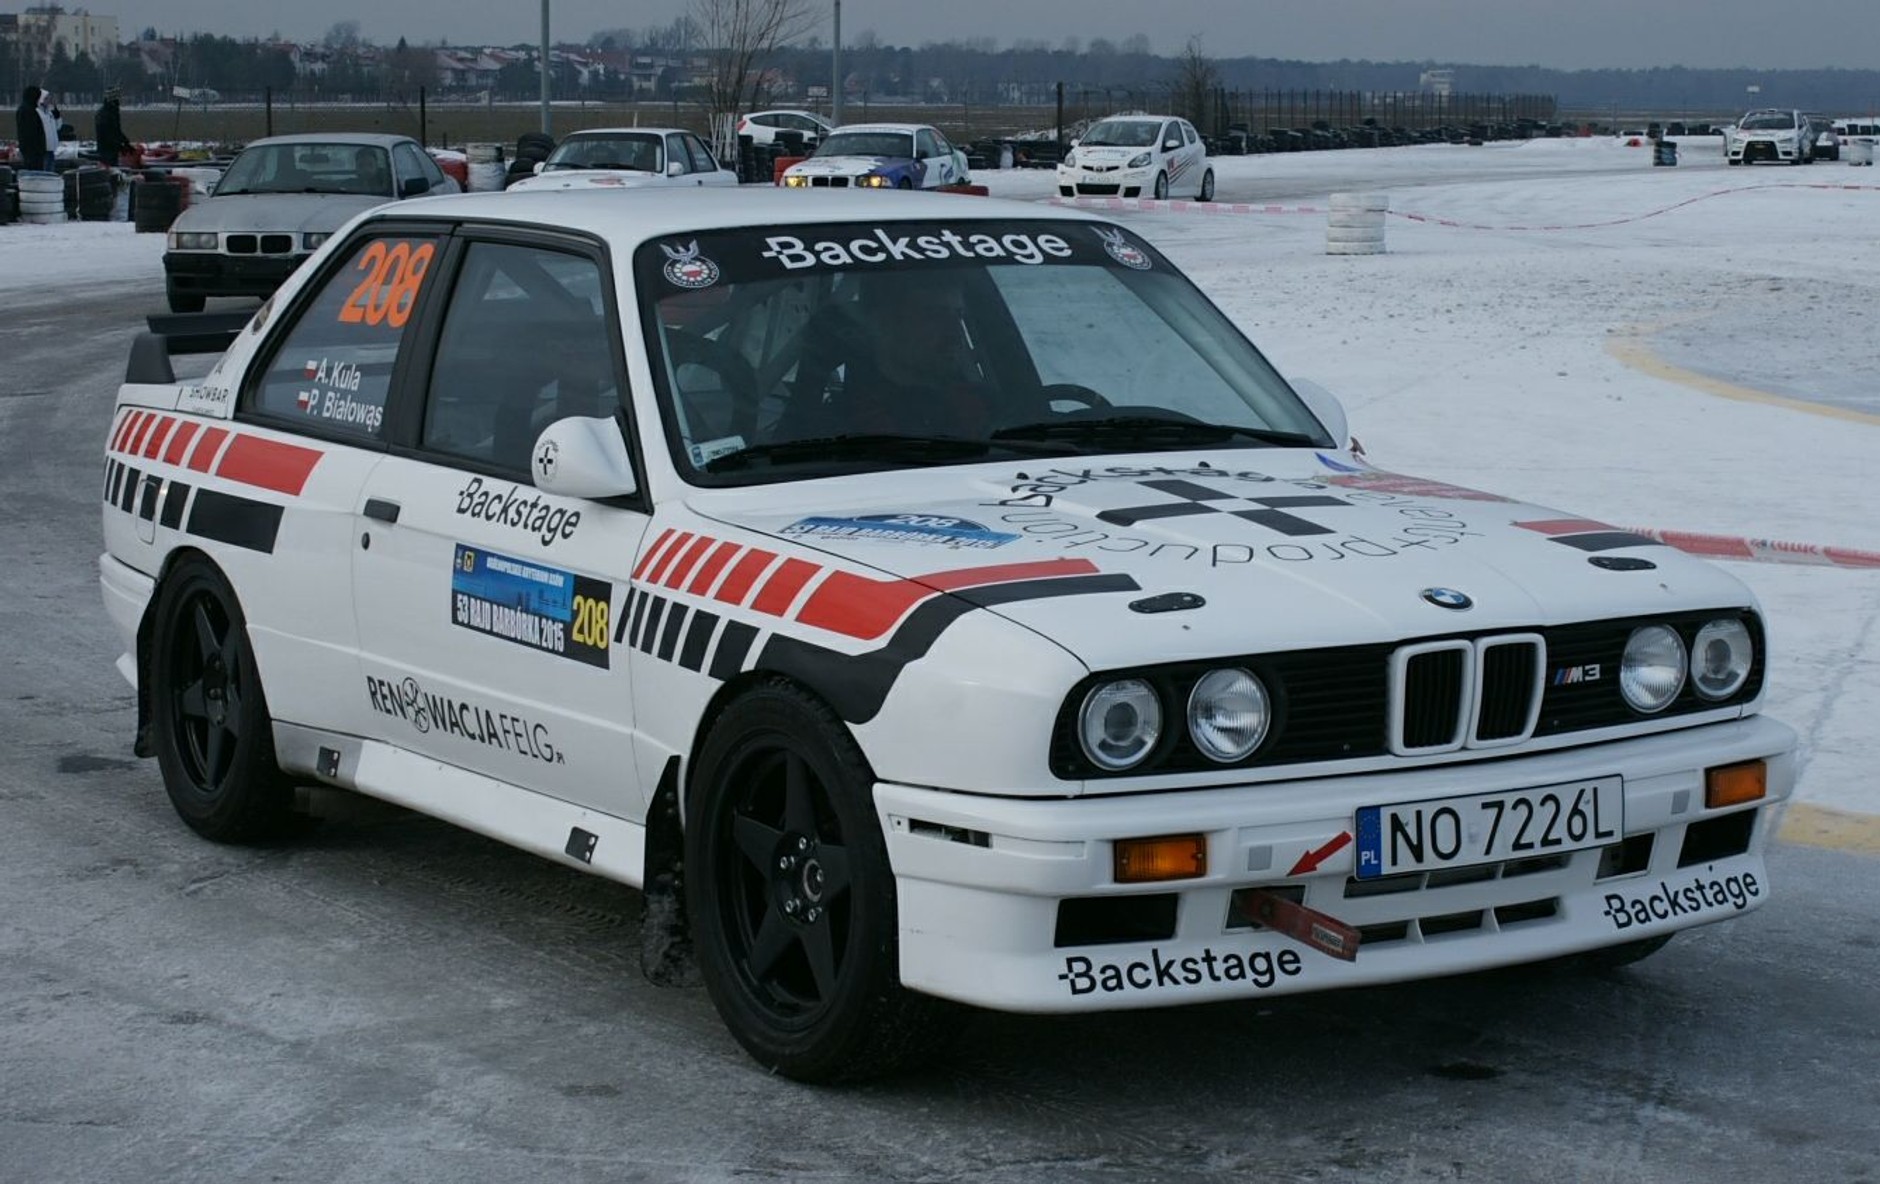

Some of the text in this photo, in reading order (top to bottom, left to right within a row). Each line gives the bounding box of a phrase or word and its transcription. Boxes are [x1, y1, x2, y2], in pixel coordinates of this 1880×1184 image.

[762, 228, 1073, 270] Backstage
[339, 241, 435, 328] 208
[330, 361, 363, 393] Kula
[306, 391, 383, 432] P. Białowąs
[456, 477, 581, 547] Backstage
[885, 515, 961, 528] 208
[456, 593, 565, 653] 53 RAJD BARBÓRKA 2015
[572, 596, 608, 649] 208
[1560, 663, 1602, 684] M3
[1390, 786, 1615, 867] NO 7226L
[1361, 851, 1379, 865] PL
[1603, 871, 1760, 930] Backstage
[1058, 948, 1303, 996] Backstage
